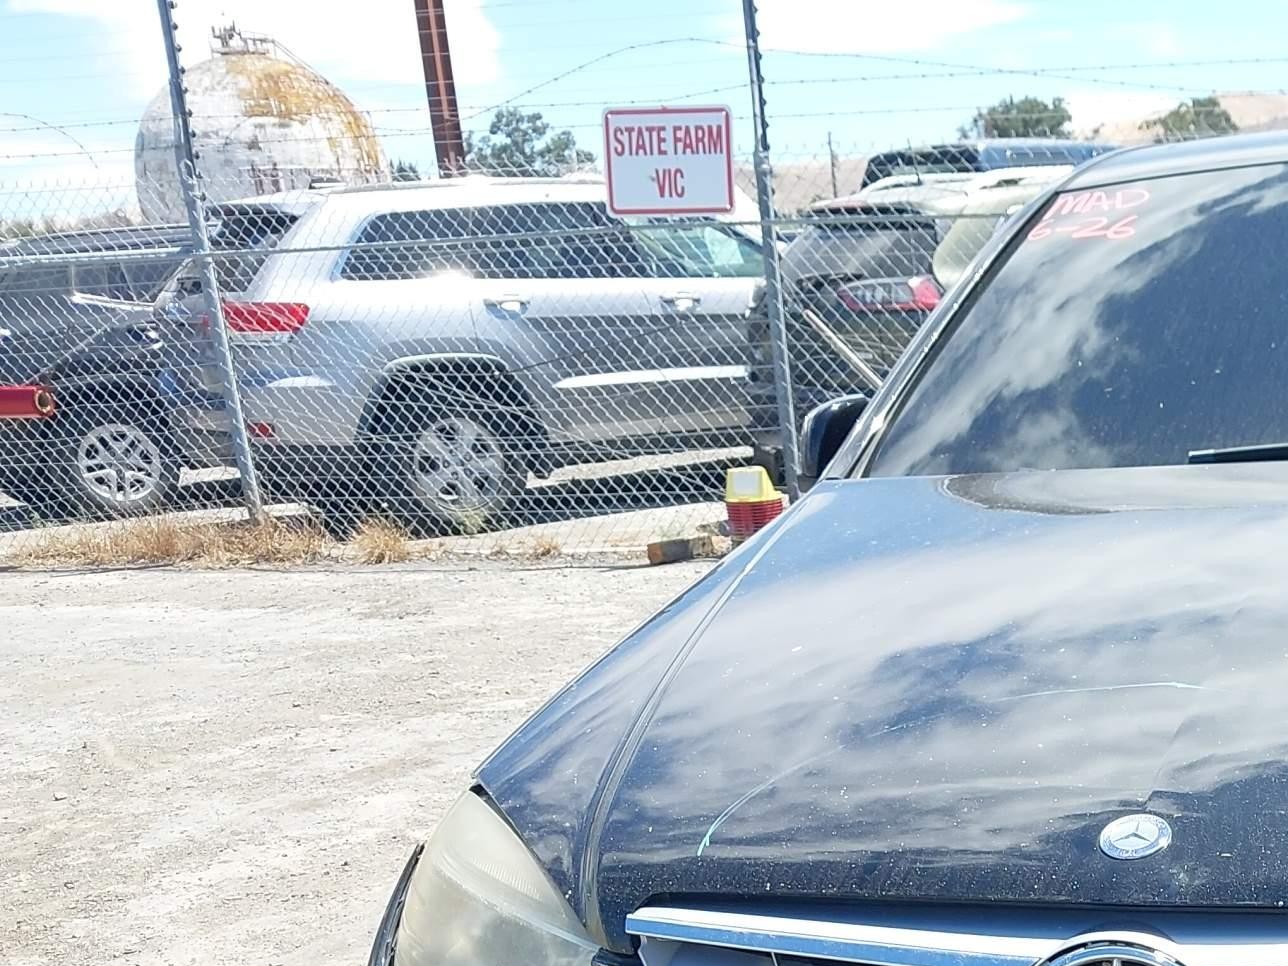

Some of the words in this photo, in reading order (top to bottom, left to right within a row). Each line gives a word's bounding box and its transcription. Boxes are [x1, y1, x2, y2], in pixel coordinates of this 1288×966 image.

[613, 125, 667, 157] STATE
[672, 124, 724, 155] FARM
[655, 167, 685, 198] VIC
